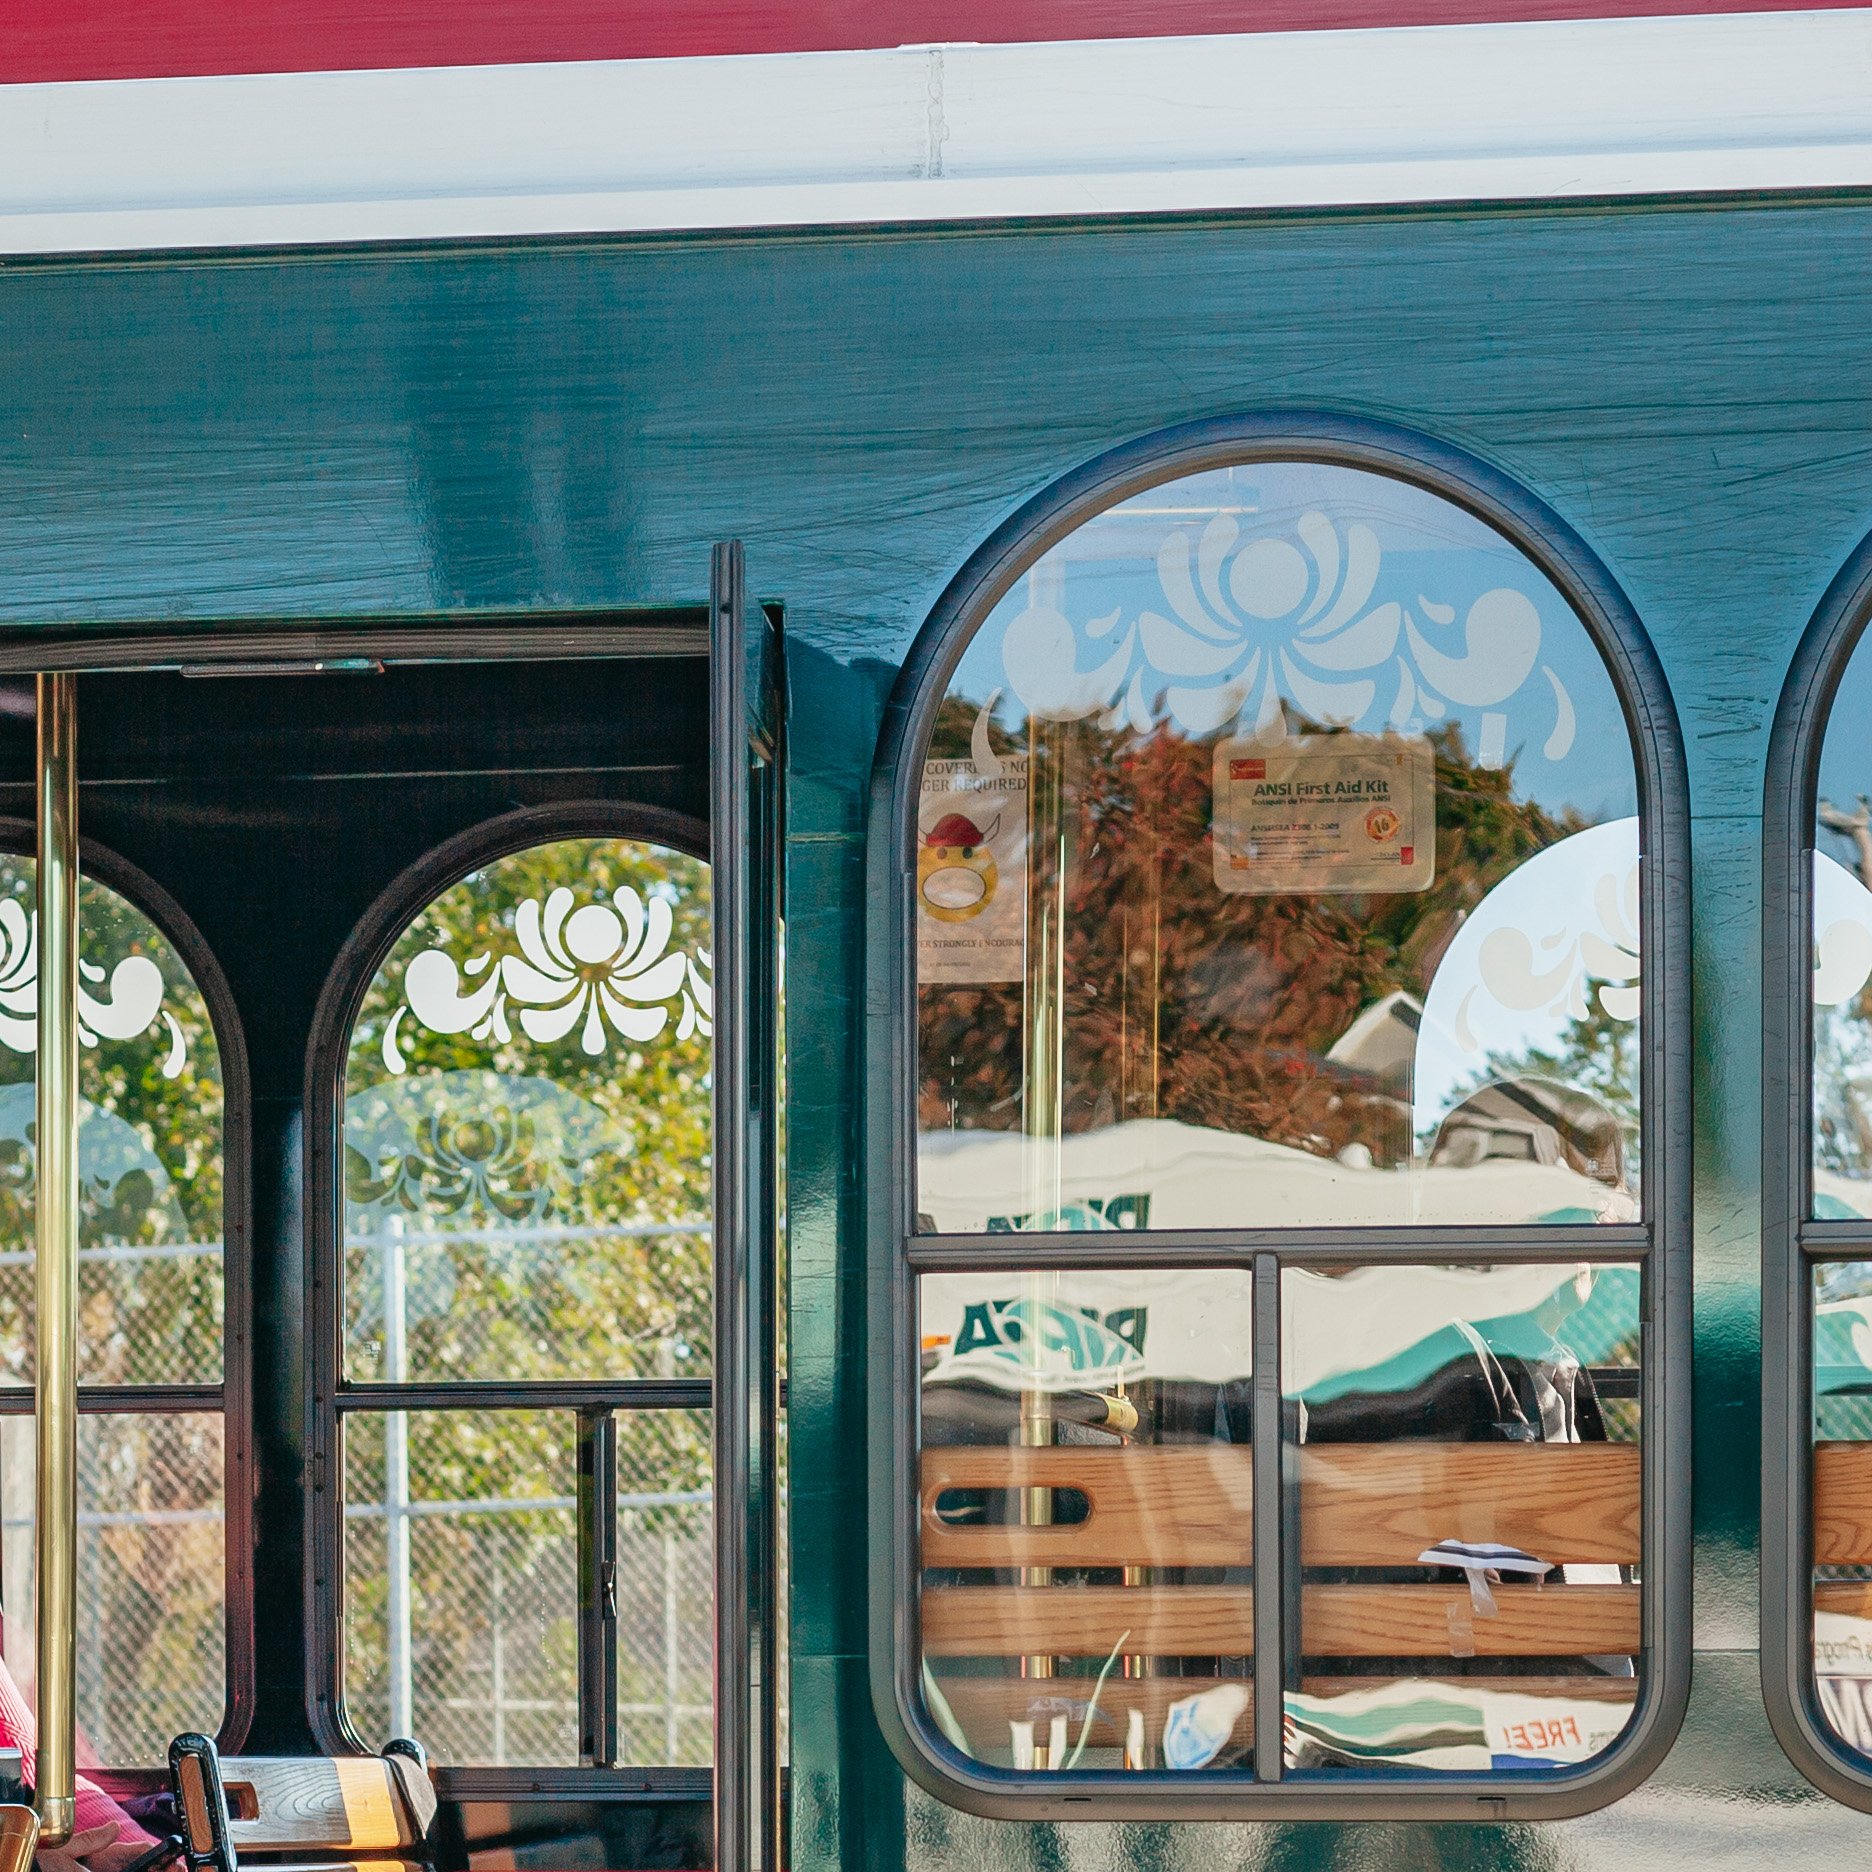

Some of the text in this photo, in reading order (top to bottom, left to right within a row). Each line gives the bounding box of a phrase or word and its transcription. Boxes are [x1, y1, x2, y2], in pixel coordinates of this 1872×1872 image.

[954, 777, 1027, 793] REQUIRED
[1253, 779, 1389, 797] ANSI First Aid Kit
[933, 939, 976, 948] STRONGLY
